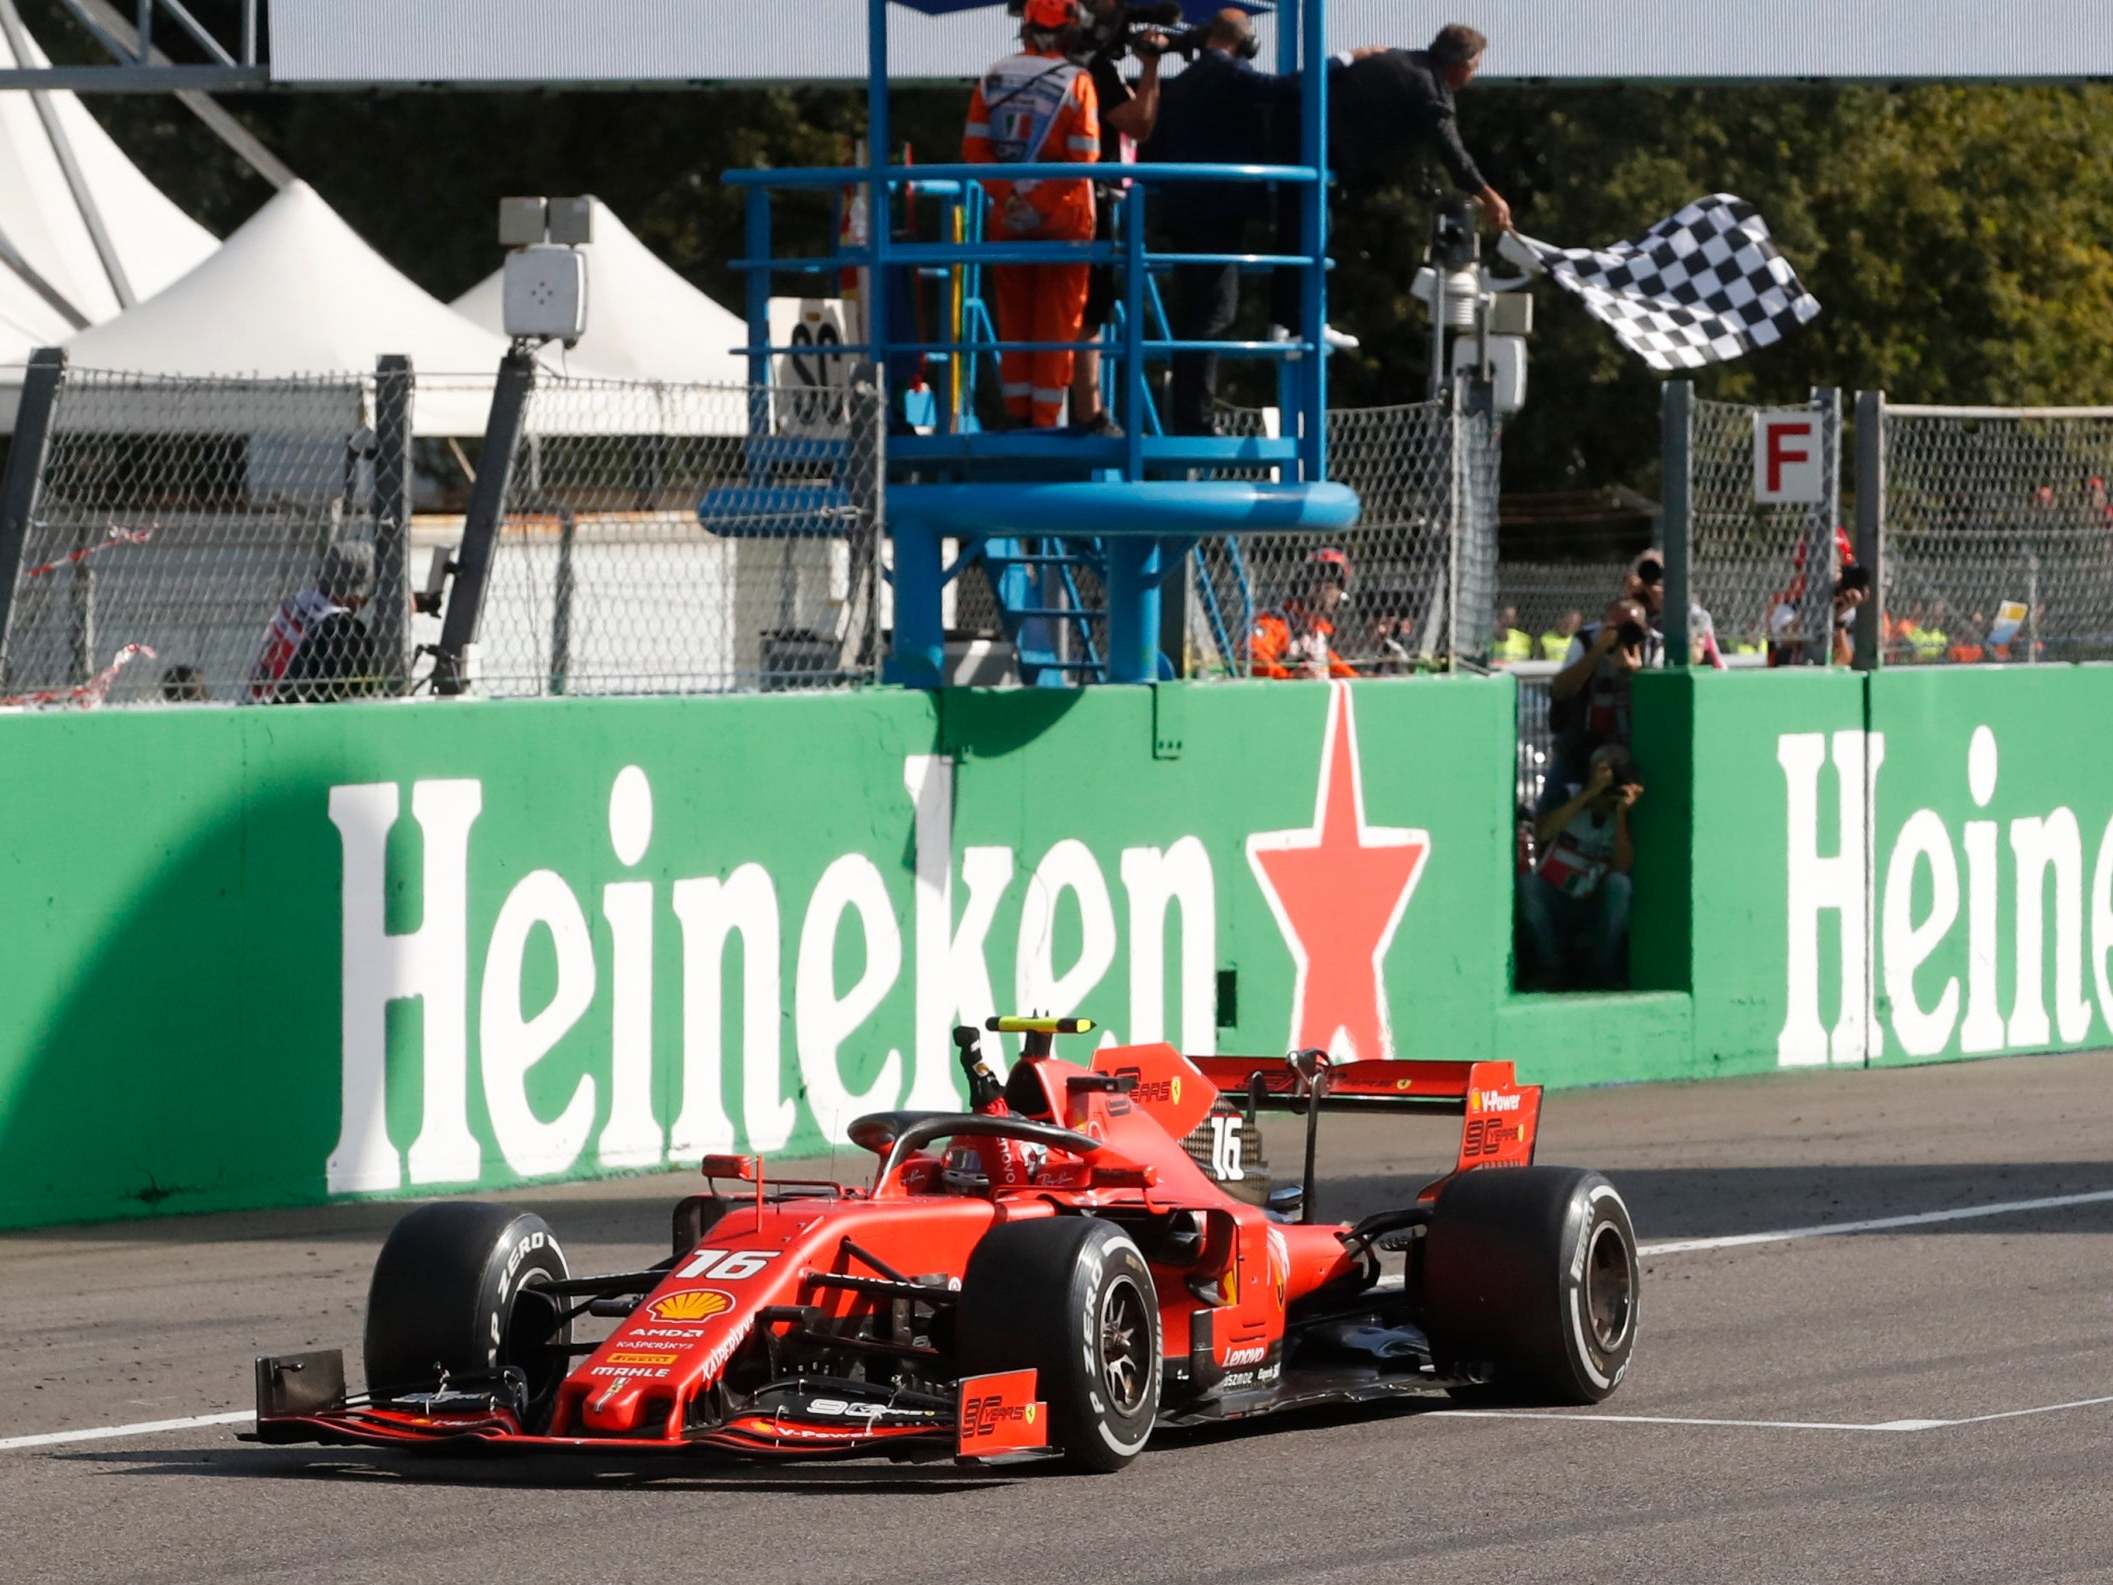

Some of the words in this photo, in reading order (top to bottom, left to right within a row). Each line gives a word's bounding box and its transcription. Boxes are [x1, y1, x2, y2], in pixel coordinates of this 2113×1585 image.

[1767, 423, 1811, 493] F
[1777, 725, 2113, 1067] Hein
[326, 755, 1217, 1194] Heineken
[1481, 1090, 1520, 1112] V-Power
[1211, 1117, 1245, 1181] 16
[498, 1231, 545, 1304] ZERO
[675, 1250, 781, 1280] 16
[629, 1328, 683, 1337] AMD
[1083, 1256, 1103, 1377] ZERO
[591, 1367, 670, 1378] MAHLE
[1222, 1347, 1264, 1367] Lenovo
